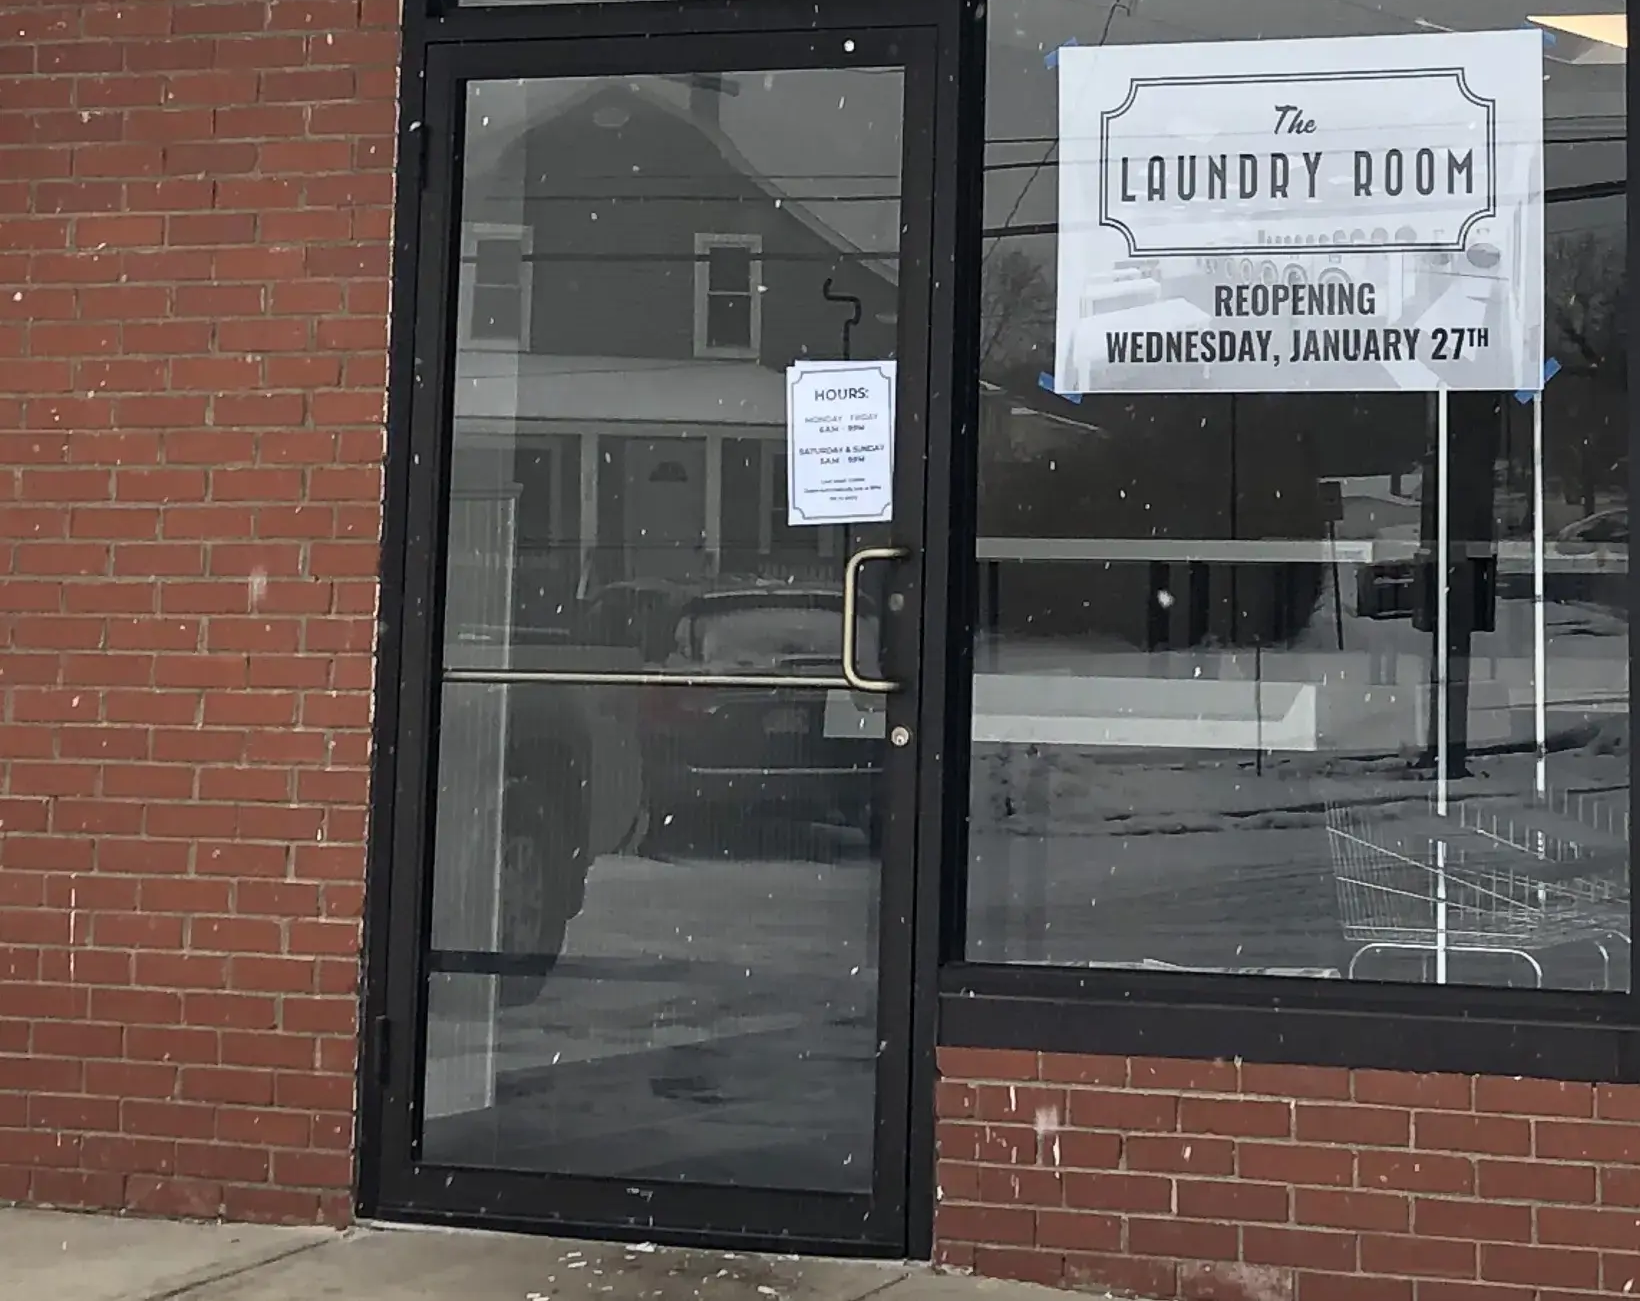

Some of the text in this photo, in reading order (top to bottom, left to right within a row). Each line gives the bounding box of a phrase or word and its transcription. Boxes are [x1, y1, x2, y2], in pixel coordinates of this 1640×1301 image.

[1273, 104, 1318, 135] The
[1121, 147, 1474, 202] LAUNDRY ROOM
[1214, 282, 1376, 317] REOPENING
[1106, 327, 1489, 366] WEDNESDAY, JANUARY 27TH
[814, 387, 869, 401] HOURS:
[799, 446, 843, 455] SATURDAY
[852, 444, 884, 453] SUNDAY
